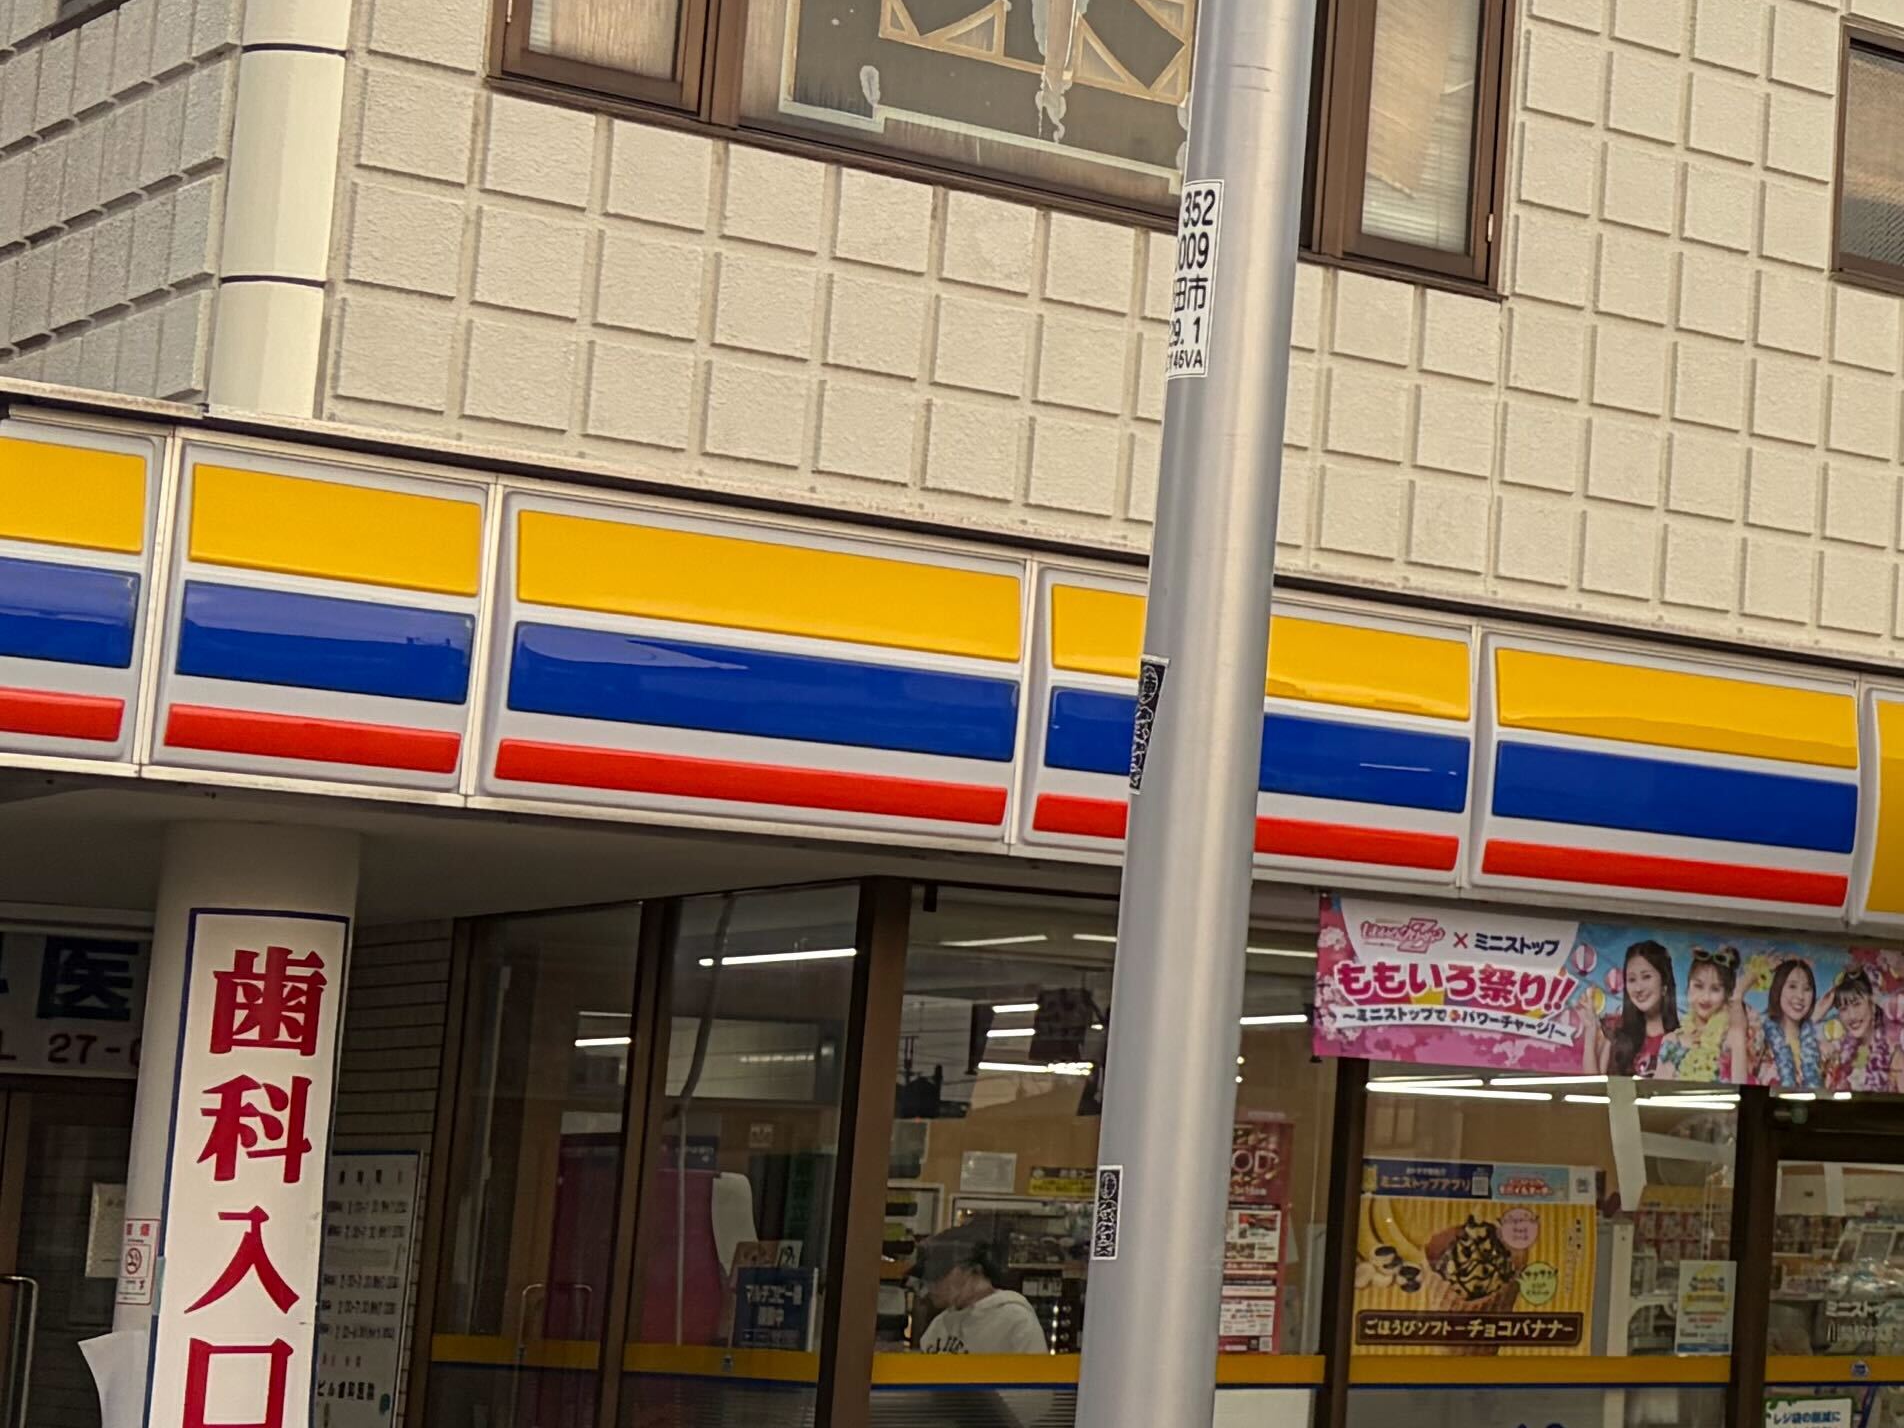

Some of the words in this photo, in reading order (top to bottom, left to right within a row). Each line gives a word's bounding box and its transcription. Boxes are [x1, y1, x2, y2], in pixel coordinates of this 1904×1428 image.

[1183, 189, 1217, 229] 352
[1474, 932, 1561, 957] ミニストップ
[0, 934, 140, 1021] 医
